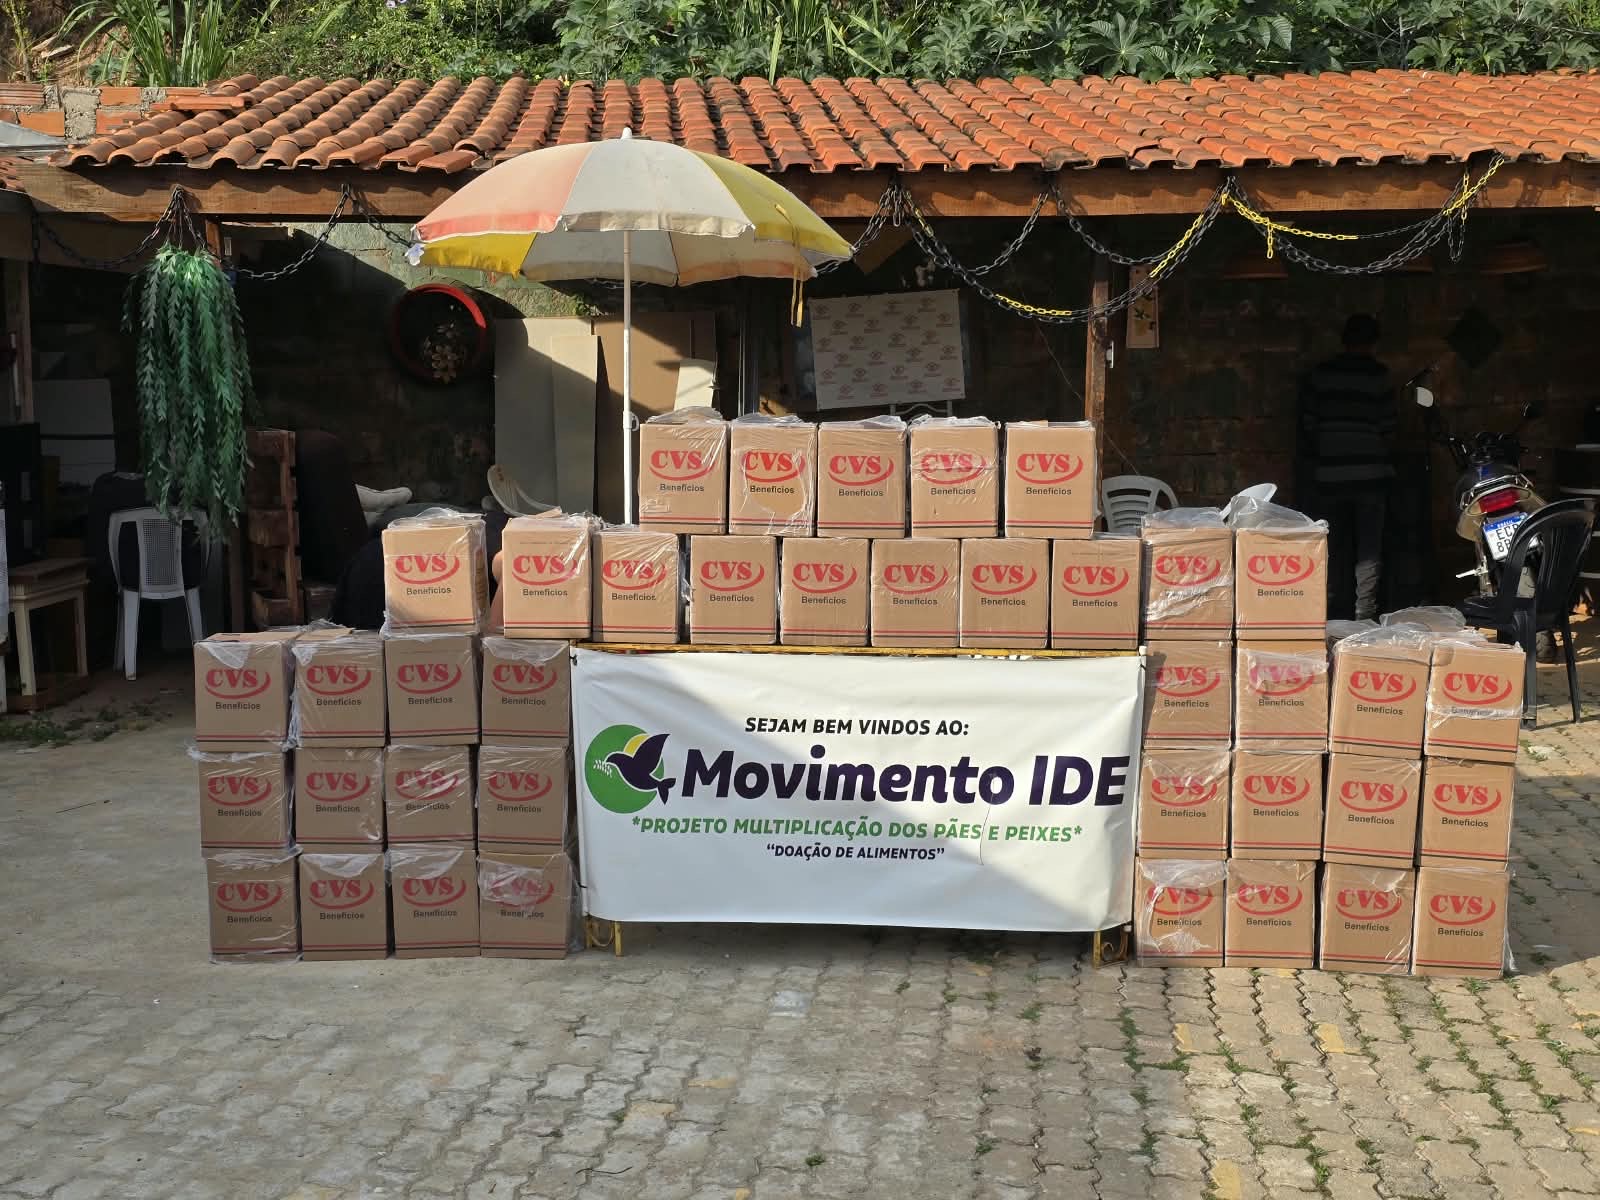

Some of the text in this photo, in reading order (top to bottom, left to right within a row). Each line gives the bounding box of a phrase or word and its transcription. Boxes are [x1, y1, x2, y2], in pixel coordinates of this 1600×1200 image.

[651, 449, 703, 471] CVS
[744, 450, 796, 472] CVS
[829, 454, 881, 475] CVS
[921, 453, 973, 474] CVS
[1016, 452, 1069, 473] CVS
[395, 553, 448, 574] CVS
[512, 554, 565, 575] CVS
[603, 559, 654, 581] CVS
[700, 560, 753, 582] CVS
[792, 563, 845, 584] CVS
[884, 563, 935, 585] CVS
[1155, 555, 1209, 574] CVS
[1247, 555, 1302, 575] CVS
[972, 564, 1024, 585] CVS
[1063, 565, 1115, 587] CVS
[206, 668, 259, 688] CVS
[306, 665, 360, 685] CVS
[397, 665, 450, 685] CVS
[492, 665, 546, 684] CVS
[1155, 665, 1208, 686] CVS
[1249, 664, 1303, 685] CVS
[1350, 670, 1406, 692] CVS
[1443, 672, 1500, 693] CVS
[745, 717, 969, 736] SEJAM BEM VINDOS AO:
[208, 775, 260, 795] CVS
[306, 772, 359, 791] CVS
[395, 771, 448, 790] CVS
[488, 771, 540, 790] CVS
[682, 744, 1131, 807] Movimento IDE
[1243, 775, 1298, 795] CVS
[1151, 777, 1207, 797] CVS
[1340, 780, 1396, 801] CVS
[1432, 783, 1489, 805] CVS
[733, 816, 883, 841] MULTIPLICAÇÃO
[888, 822, 927, 838] DOS
[933, 818, 982, 840] PÃES
[988, 825, 1000, 840] E
[767, 843, 945, 861] “DOAÇÃO DE ALIMENTOS”
[216, 882, 270, 901] CVS
[309, 879, 362, 899] CVS
[403, 877, 456, 896] CVS
[1237, 884, 1290, 904] CVS
[1337, 889, 1391, 910] CVS
[1429, 894, 1484, 915] CVS
